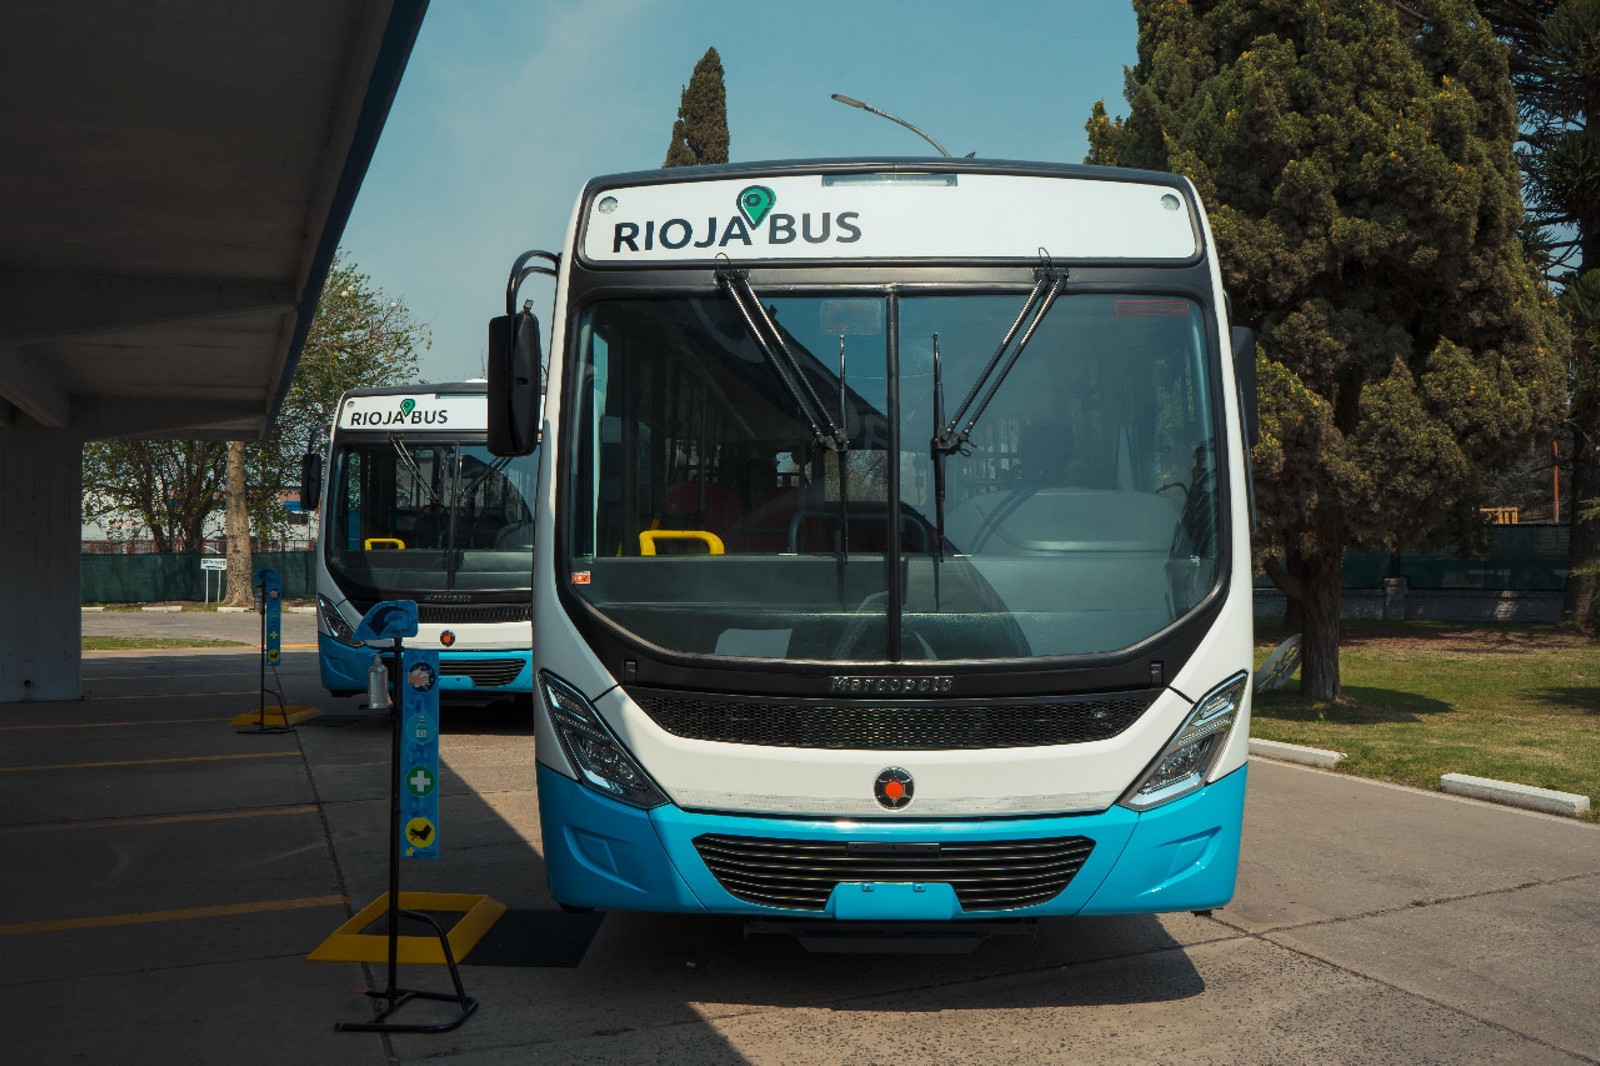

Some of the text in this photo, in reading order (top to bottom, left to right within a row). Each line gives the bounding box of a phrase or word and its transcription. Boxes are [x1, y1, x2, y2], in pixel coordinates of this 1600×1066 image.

[613, 211, 862, 253] RIOJA BUS
[350, 410, 448, 426] RIOJA BUS
